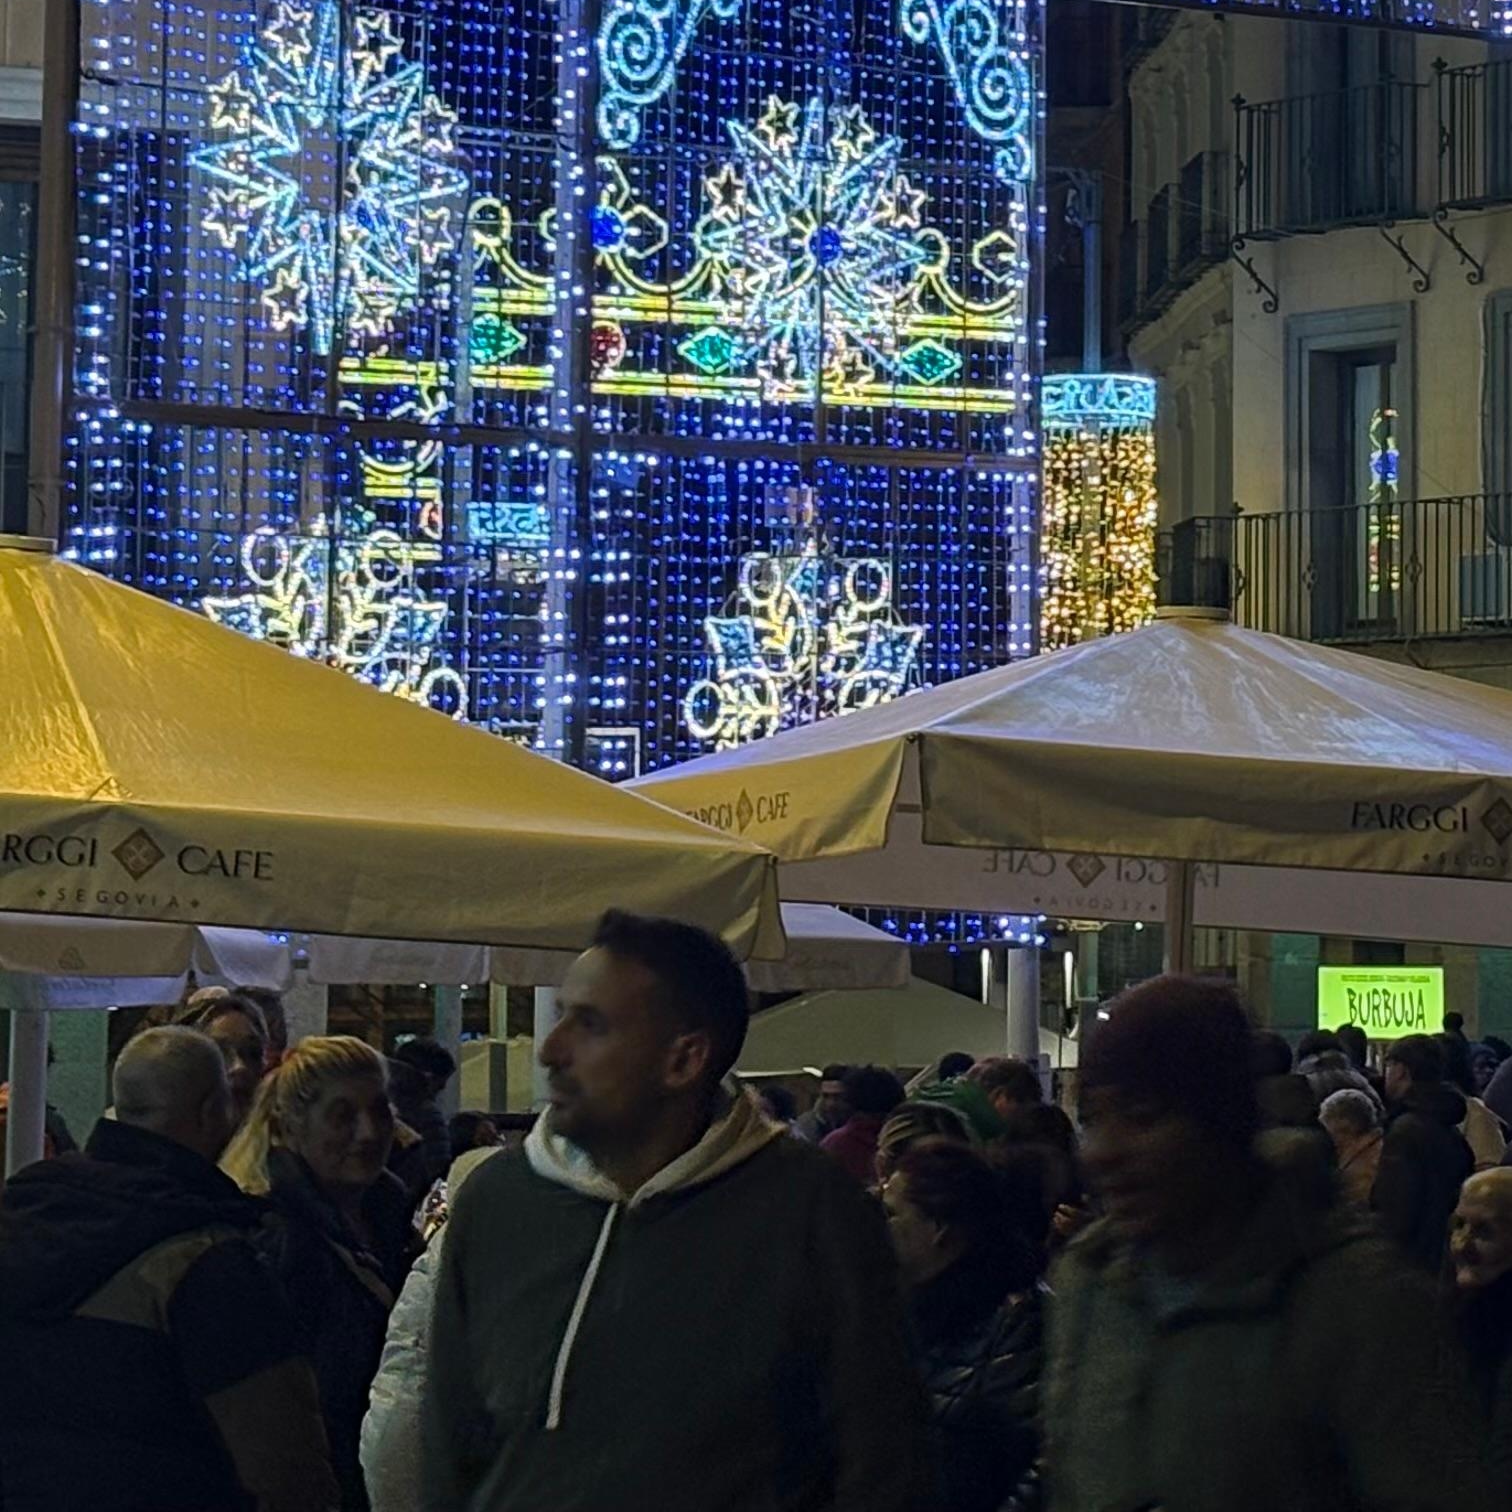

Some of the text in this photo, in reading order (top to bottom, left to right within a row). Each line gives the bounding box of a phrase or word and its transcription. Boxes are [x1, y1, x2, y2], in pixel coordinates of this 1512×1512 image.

[684, 791, 790, 830] RGGI CAFE
[1350, 801, 1469, 833] FARGGI
[0, 833, 275, 881] RGGI CAFE
[56, 888, 180, 908] SEGOVIA
[1346, 987, 1427, 1030] BURBUJA
